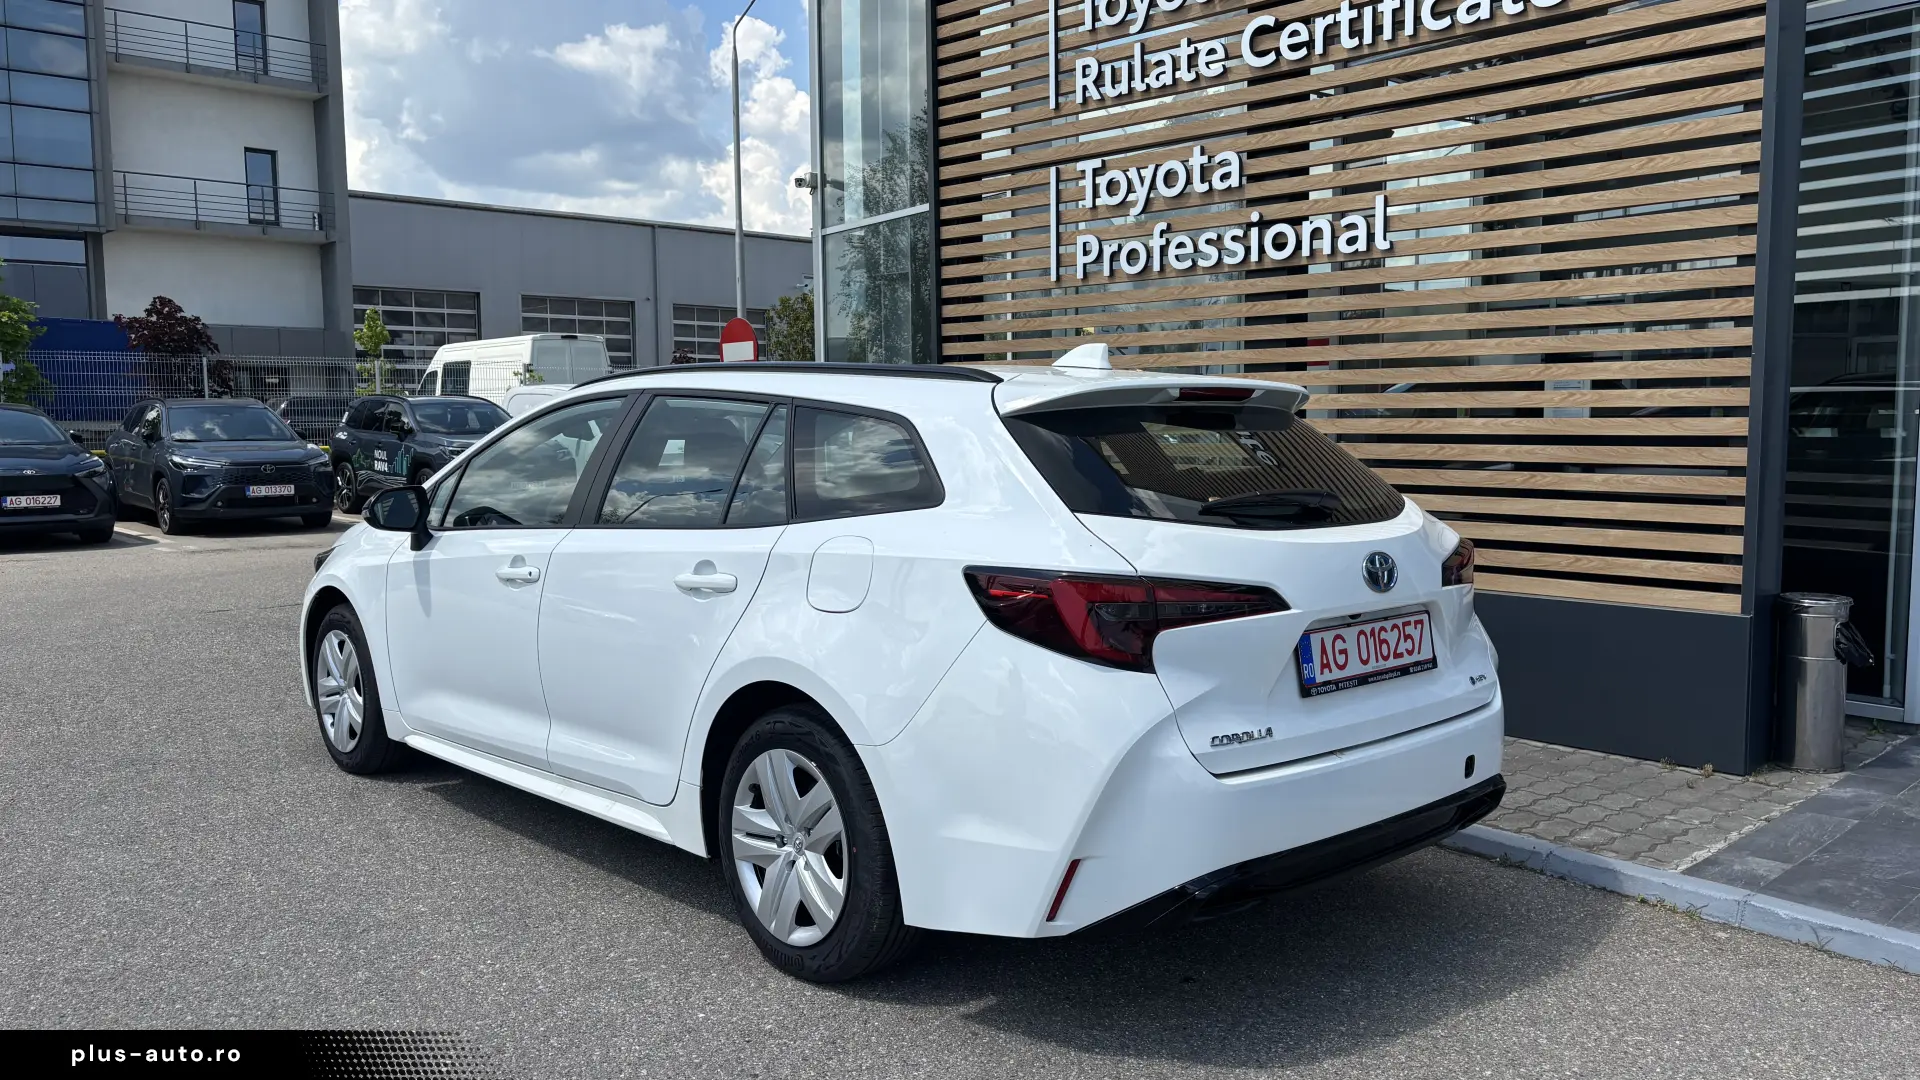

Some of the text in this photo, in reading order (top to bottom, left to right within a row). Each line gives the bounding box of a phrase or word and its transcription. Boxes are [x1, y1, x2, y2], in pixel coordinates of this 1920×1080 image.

[1075, 0, 1562, 104] Rulate Certifica
[1077, 145, 1243, 216] Toyota
[1076, 195, 1391, 280] Professional
[374, 449, 387, 460] NOUL
[374, 460, 388, 472] RAV4
[251, 485, 292, 494] AG 013370
[9, 496, 58, 506] AG 016227
[1319, 618, 1425, 675] AG 016257
[1303, 662, 1315, 679] RO
[1317, 684, 1337, 694] TOYOTA
[1210, 726, 1274, 747] COROLLA
